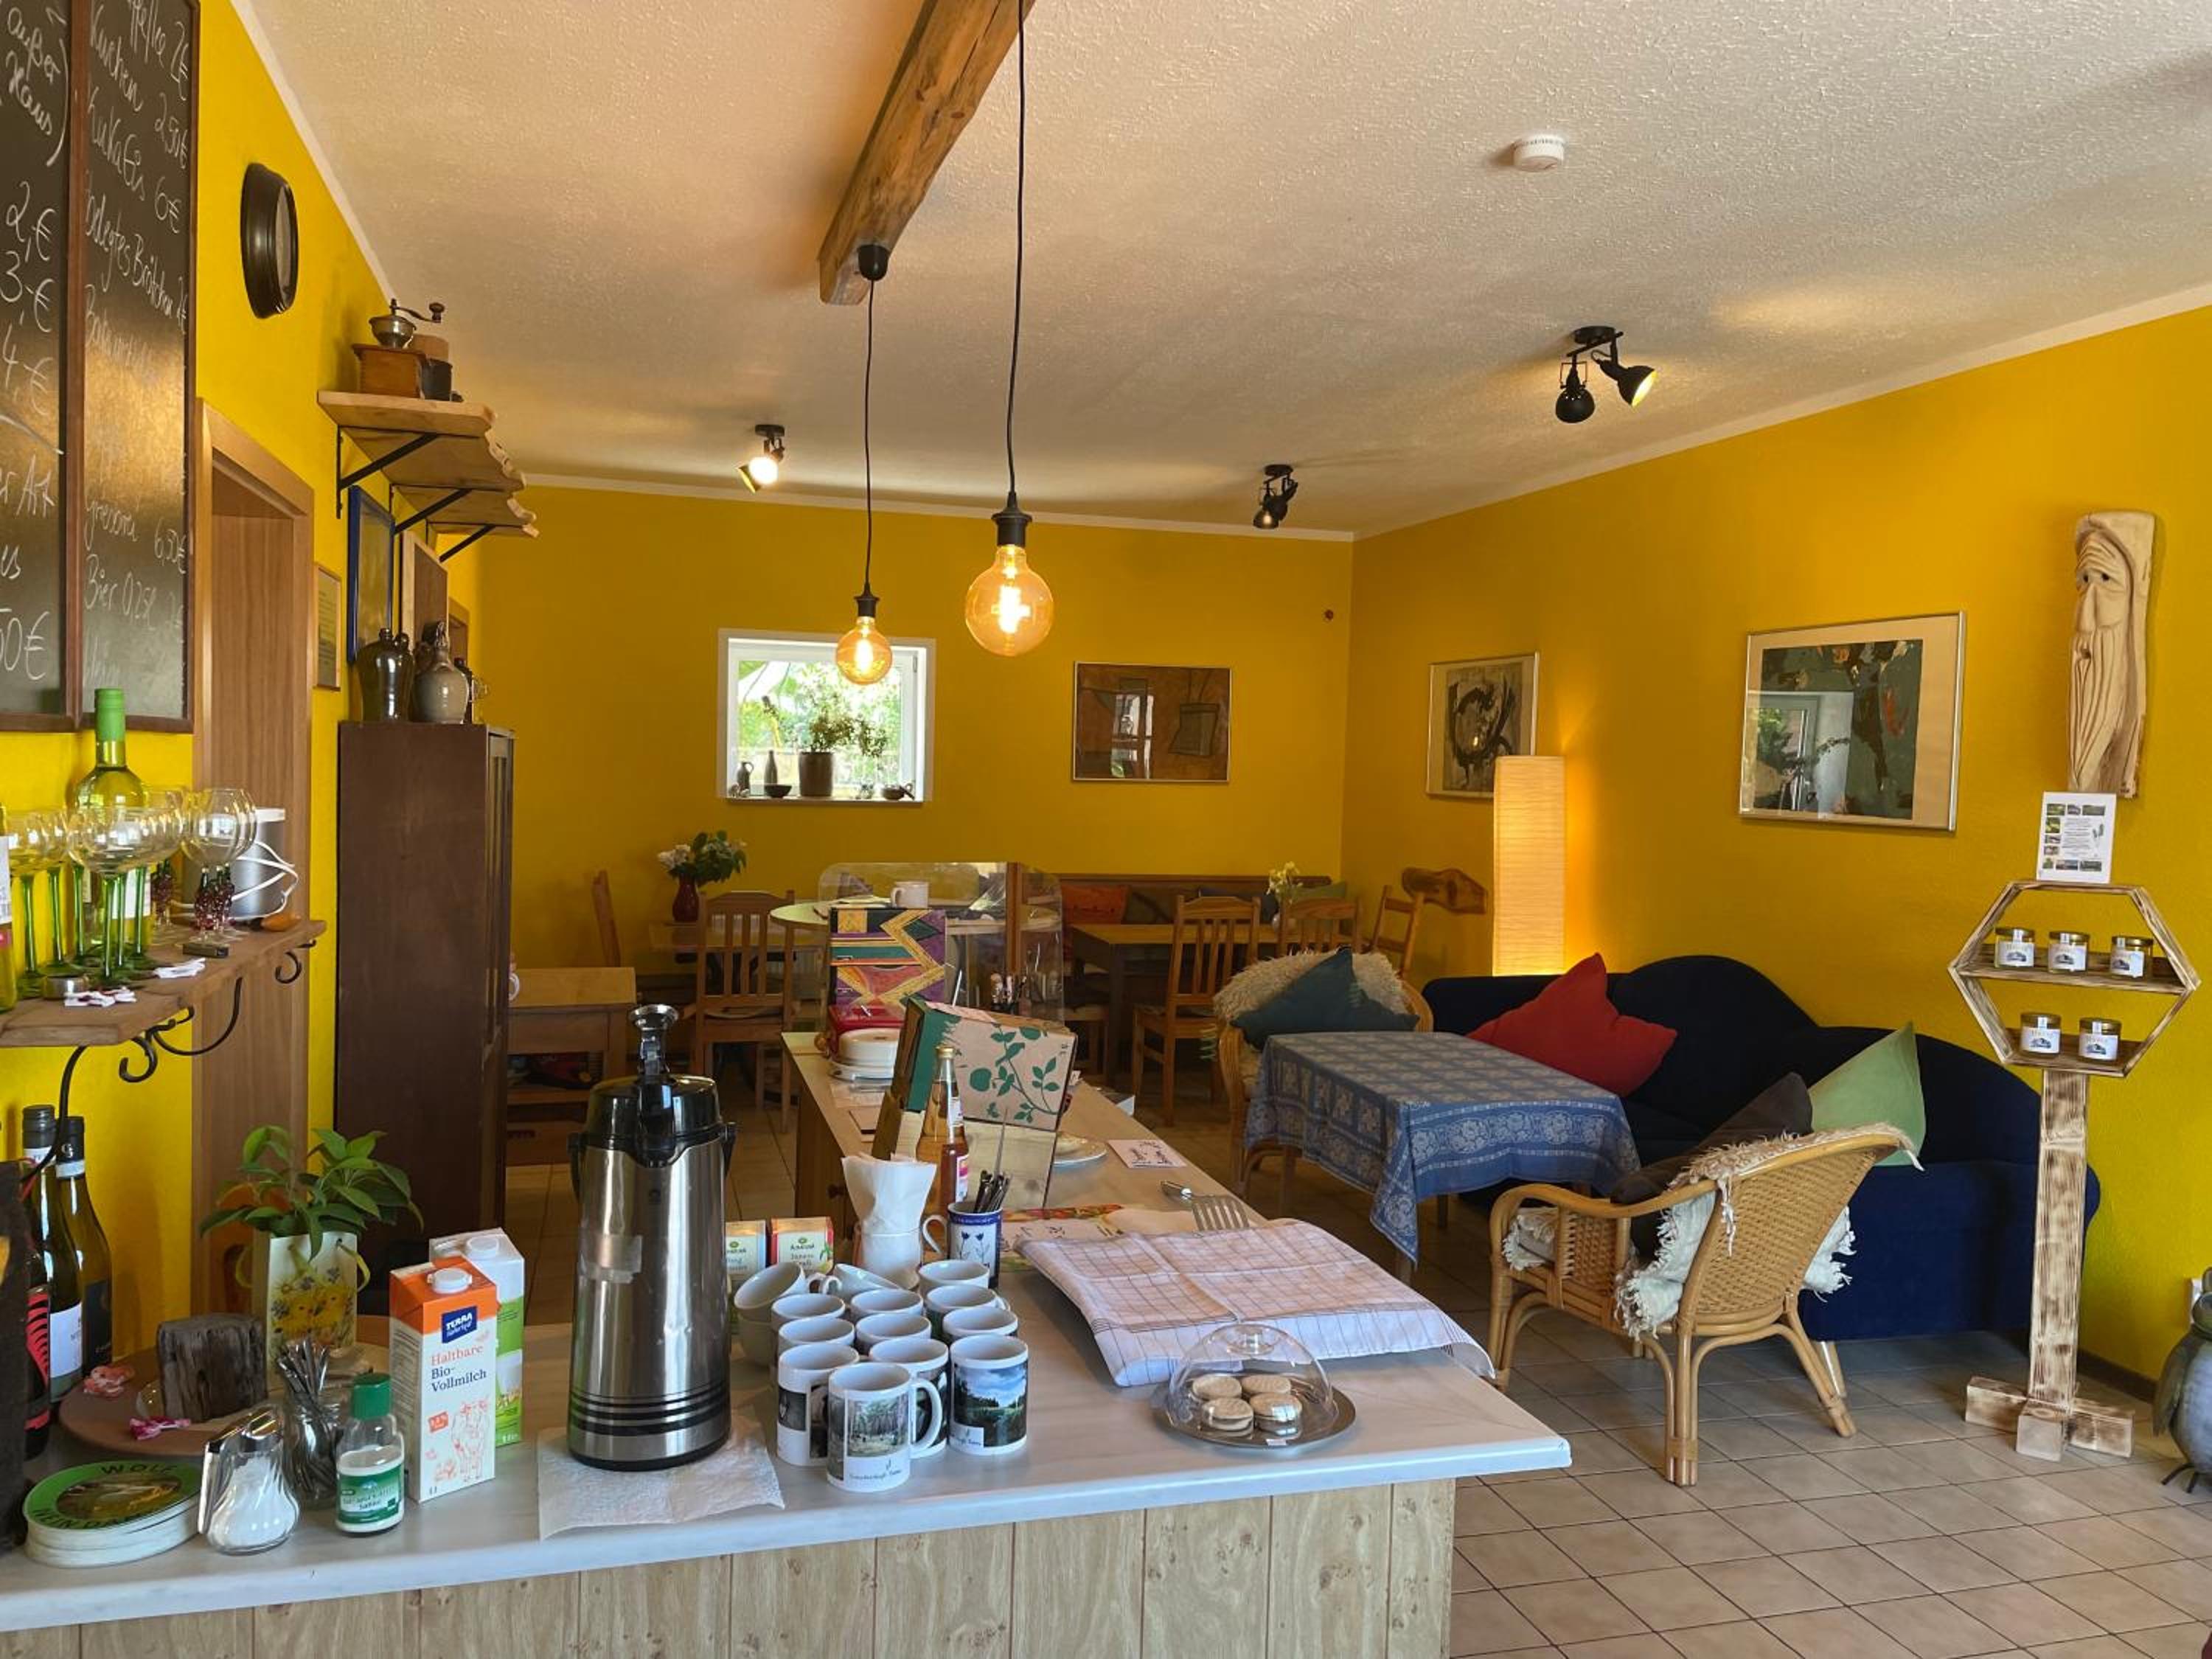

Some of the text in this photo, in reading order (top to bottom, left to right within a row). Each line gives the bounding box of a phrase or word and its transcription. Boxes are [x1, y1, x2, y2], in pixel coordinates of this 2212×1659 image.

[91, 4, 145, 111] Kuchen
[154, 176, 182, 234] 6€
[85, 554, 118, 610] Bier
[431, 1344, 484, 1366] Haltbare
[431, 1366, 455, 1379] Bio-
[431, 1368, 487, 1391] Vollmilch
